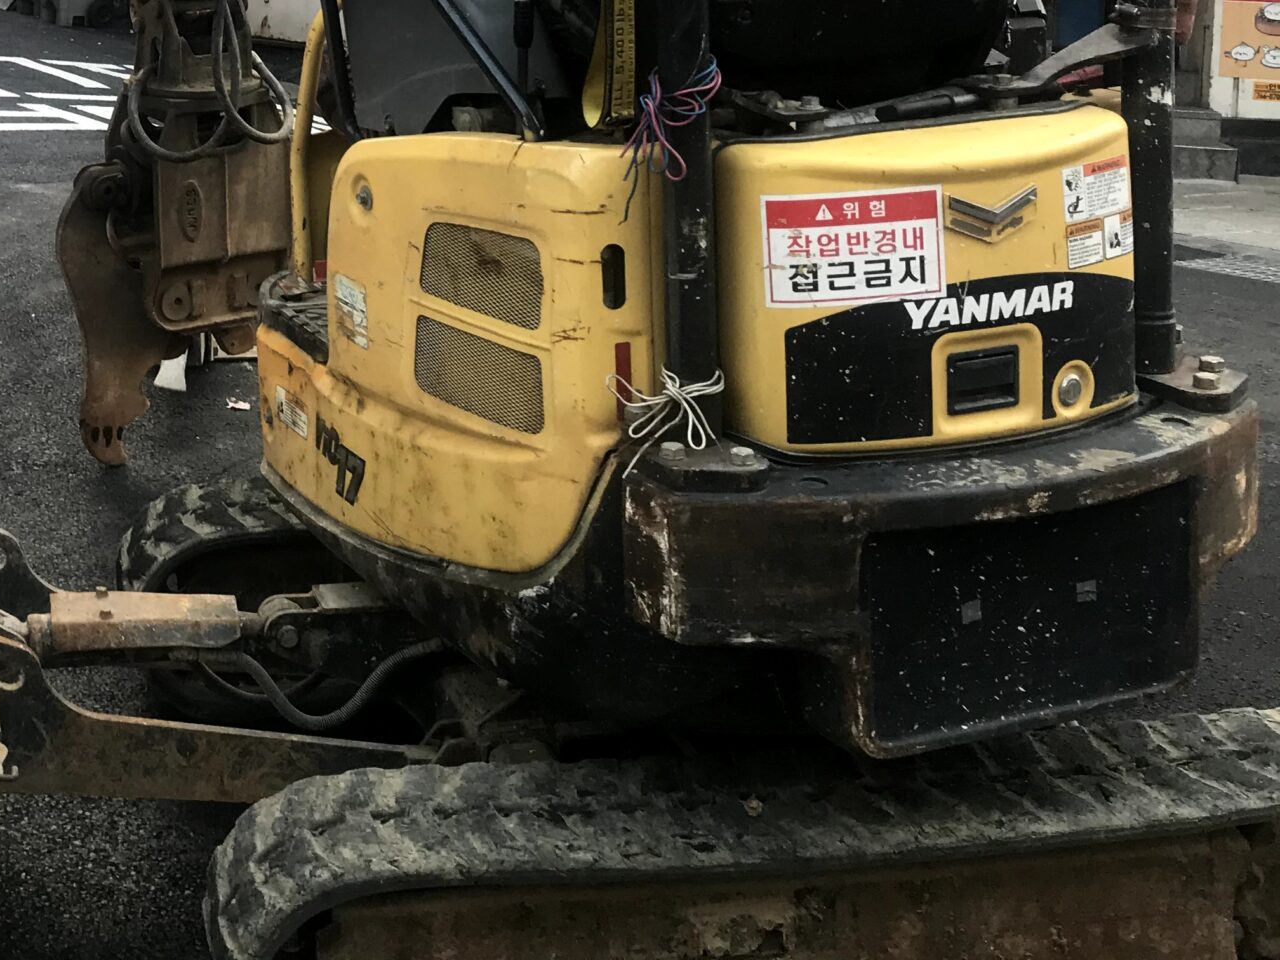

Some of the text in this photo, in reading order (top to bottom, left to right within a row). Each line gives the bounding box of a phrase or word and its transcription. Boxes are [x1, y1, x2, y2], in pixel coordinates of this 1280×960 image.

[786, 225, 926, 259] 작업반경내
[788, 254, 928, 293] 접근금지
[903, 280, 1074, 330] YANMAR
